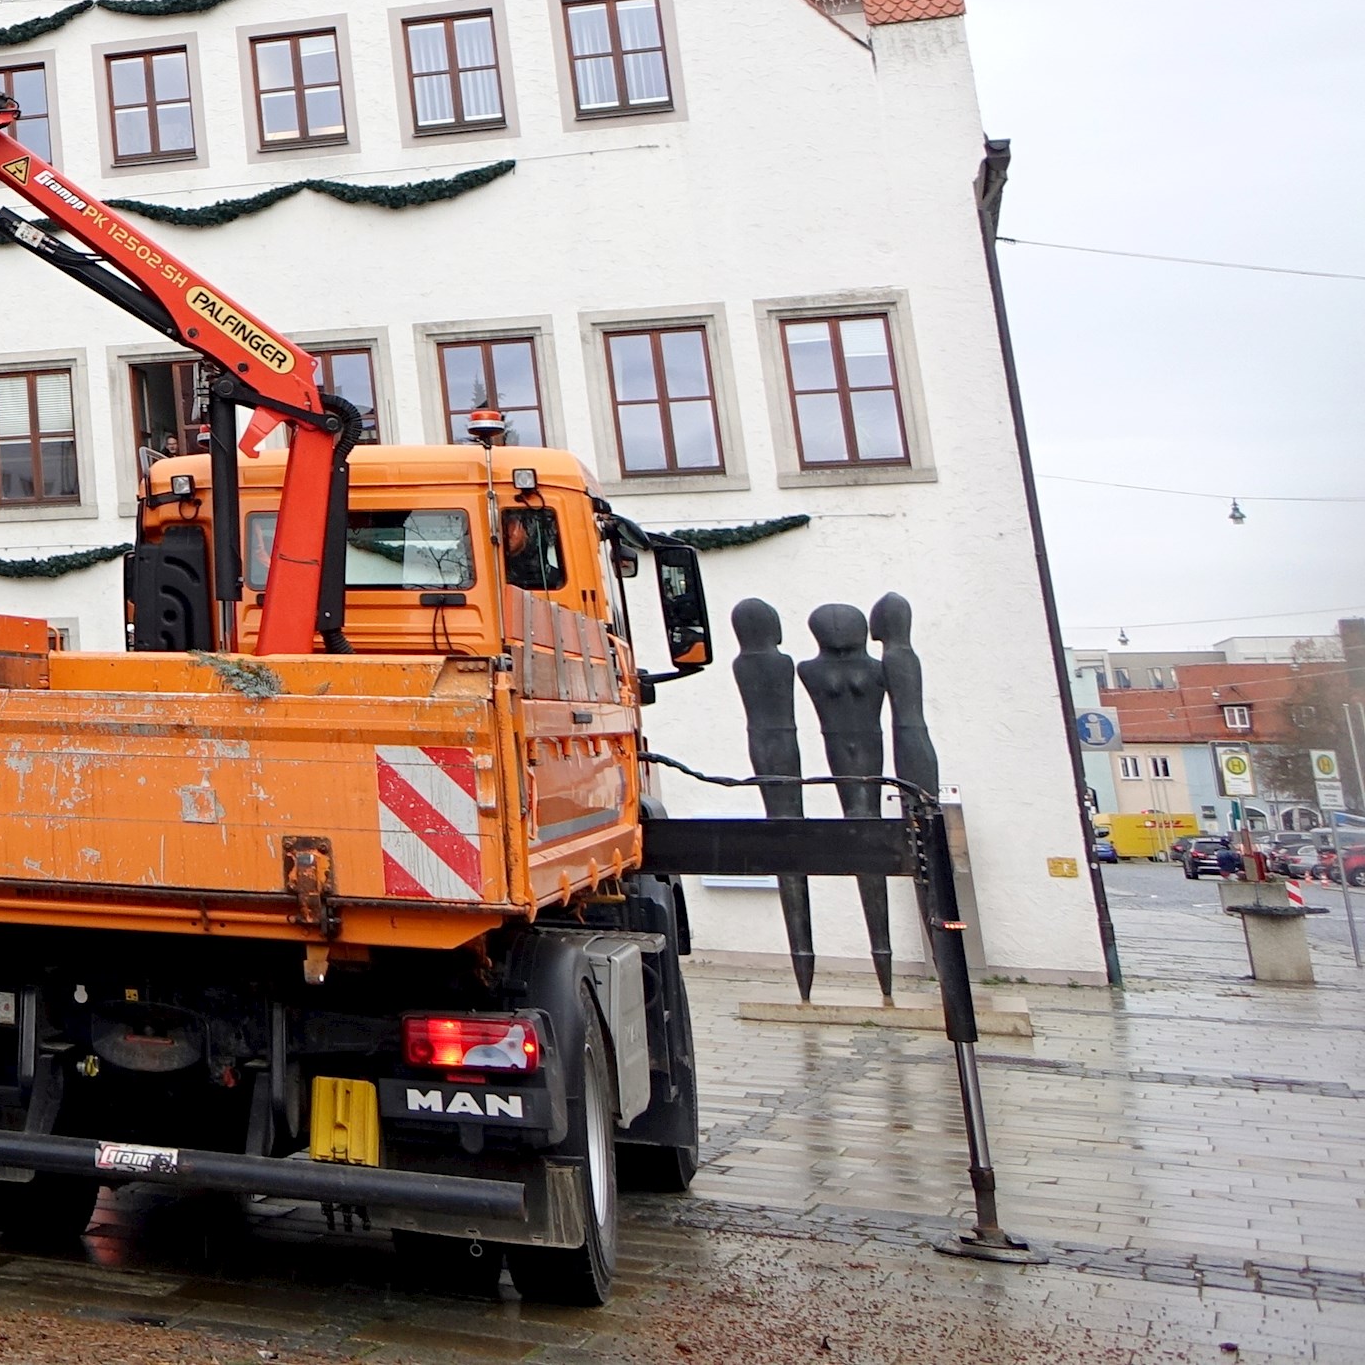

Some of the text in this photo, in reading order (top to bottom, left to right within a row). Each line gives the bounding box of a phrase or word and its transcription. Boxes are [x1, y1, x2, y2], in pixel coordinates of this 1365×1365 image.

[34, 170, 87, 211] Grampp
[82, 205, 109, 229] PK
[192, 291, 287, 369] PALFINGER
[406, 1088, 524, 1119] MAN
